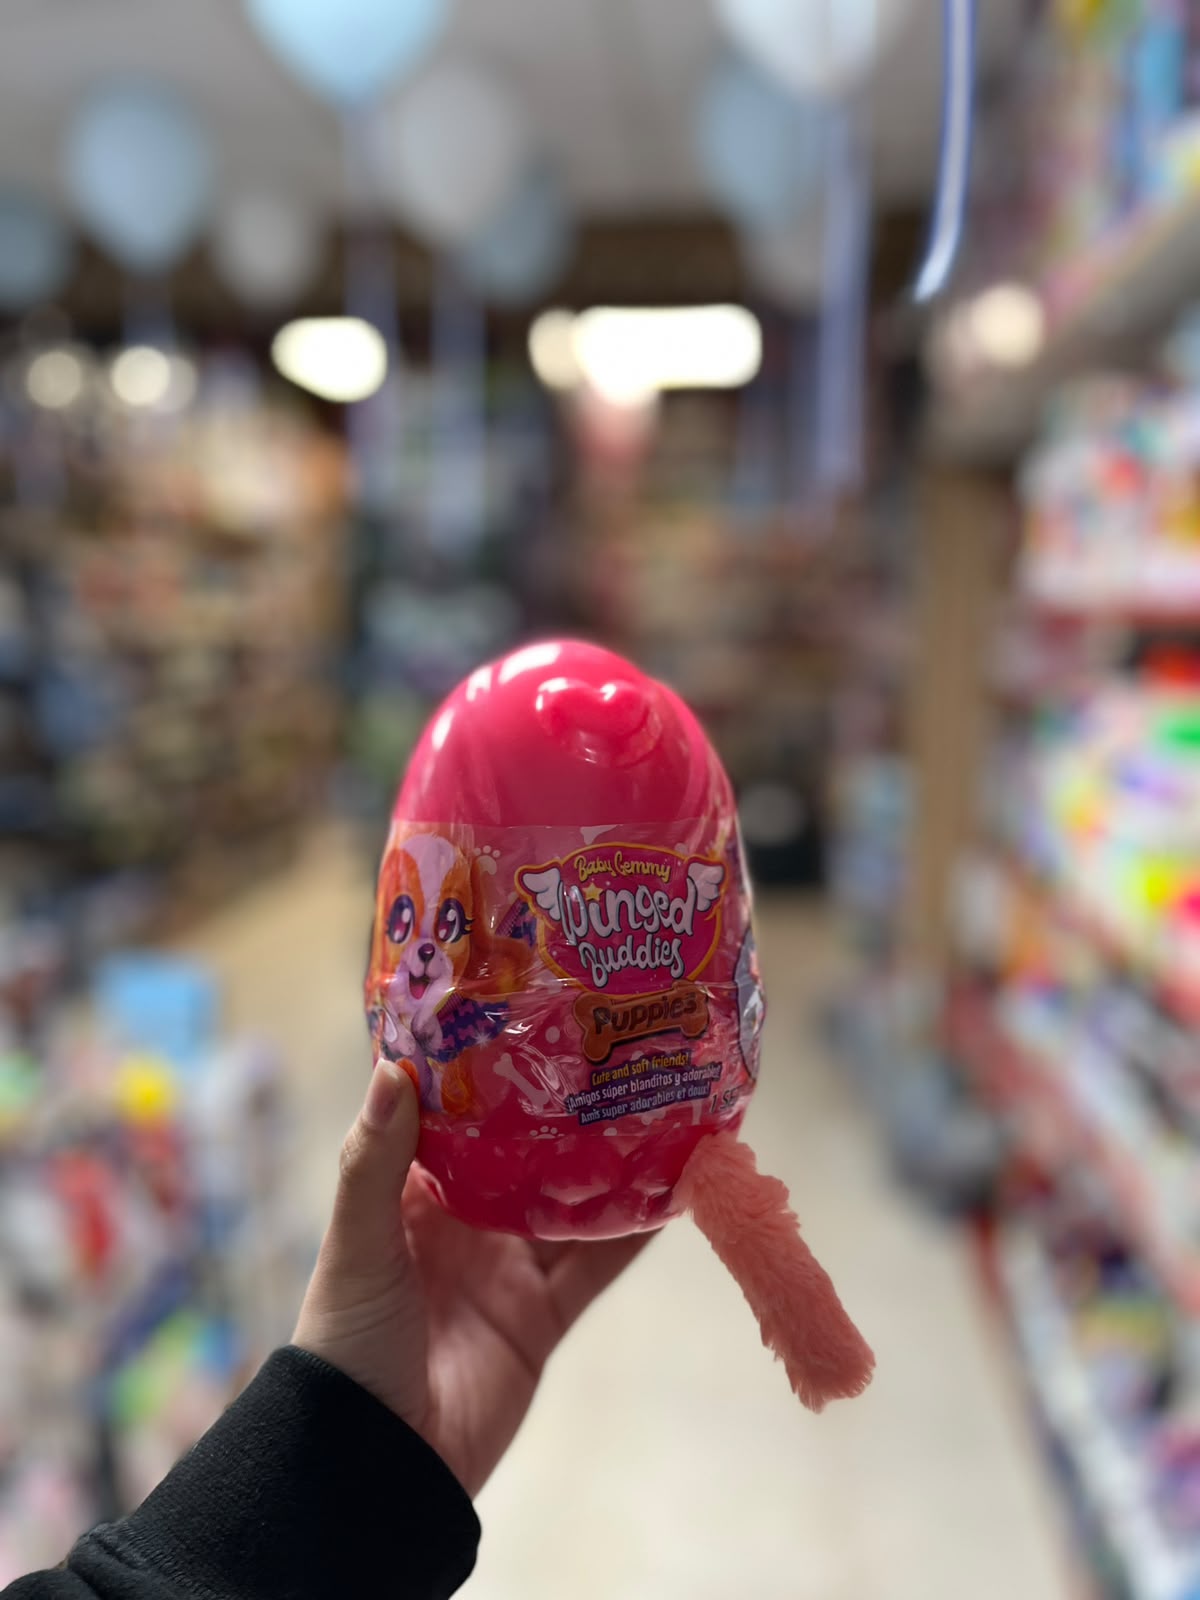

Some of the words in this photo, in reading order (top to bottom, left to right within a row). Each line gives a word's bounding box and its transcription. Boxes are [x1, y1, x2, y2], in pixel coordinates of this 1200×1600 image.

[574, 855, 617, 882] Baby
[614, 850, 672, 883] Gemmy
[558, 876, 698, 946] Winged
[578, 934, 685, 988] Buddies
[592, 1071, 610, 1087] Cute
[612, 1066, 629, 1082] and
[632, 1058, 650, 1074] soft
[651, 1052, 690, 1070] friends!
[602, 1084, 628, 1102] súper
[630, 1072, 673, 1093] blanditos
[674, 1074, 681, 1087] y
[581, 1107, 600, 1124] Amis
[602, 1102, 628, 1119] super
[630, 1089, 675, 1113] adorables
[676, 1088, 686, 1101] et
